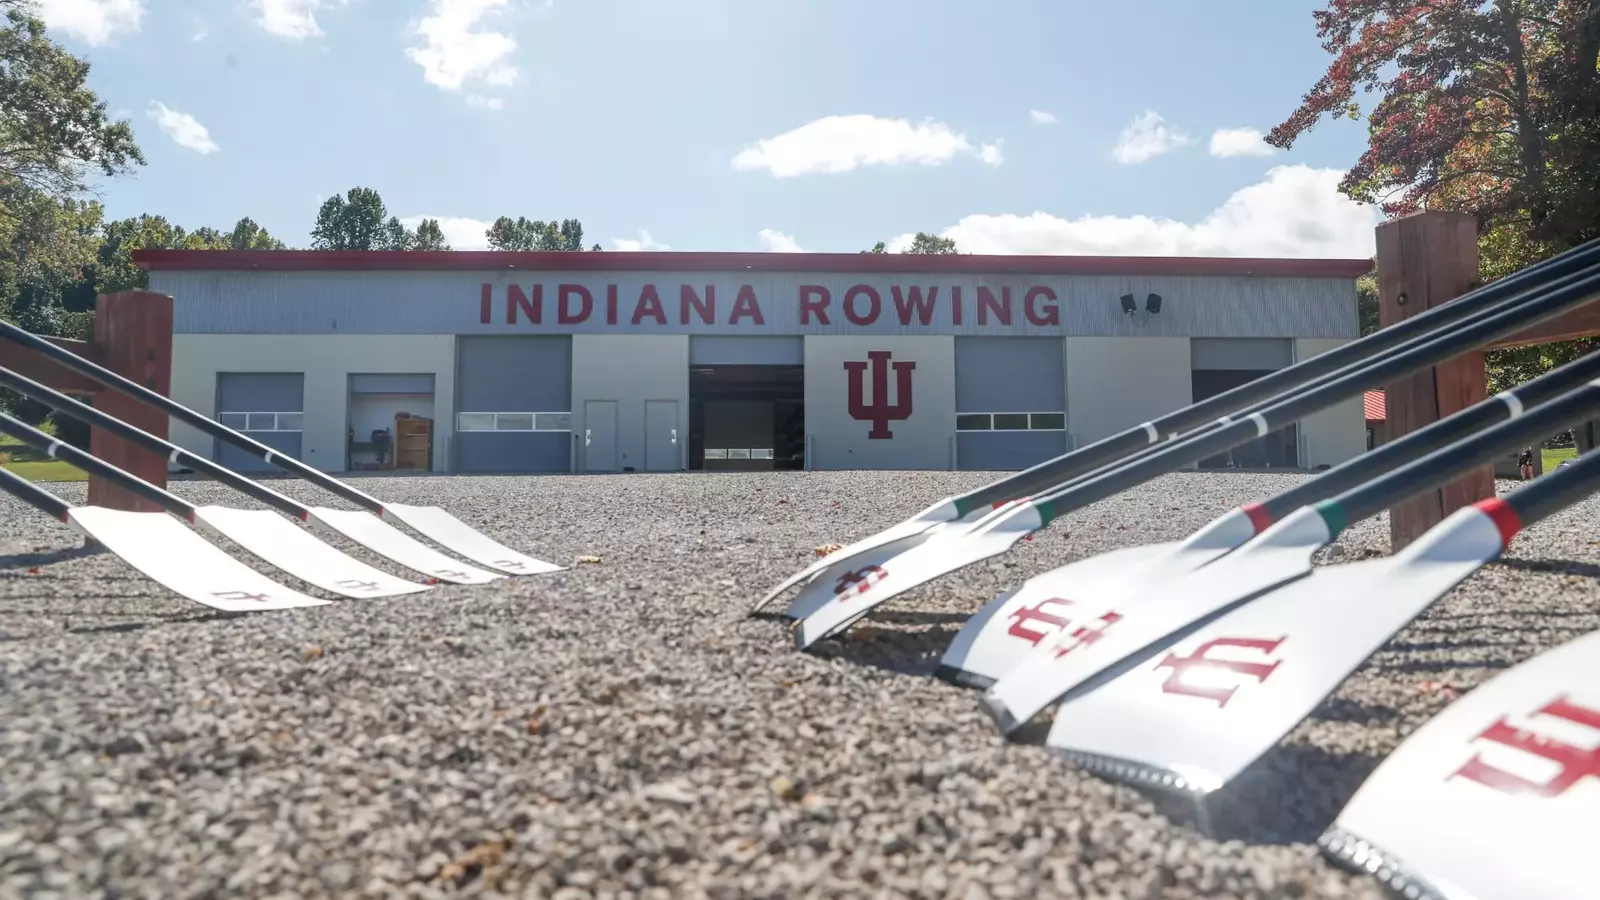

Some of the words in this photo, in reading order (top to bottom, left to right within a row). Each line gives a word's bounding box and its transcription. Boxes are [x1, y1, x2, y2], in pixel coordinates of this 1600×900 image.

[479, 283, 766, 325] INDIANA
[799, 284, 1060, 326] ROWING
[843, 350, 917, 440] IU
